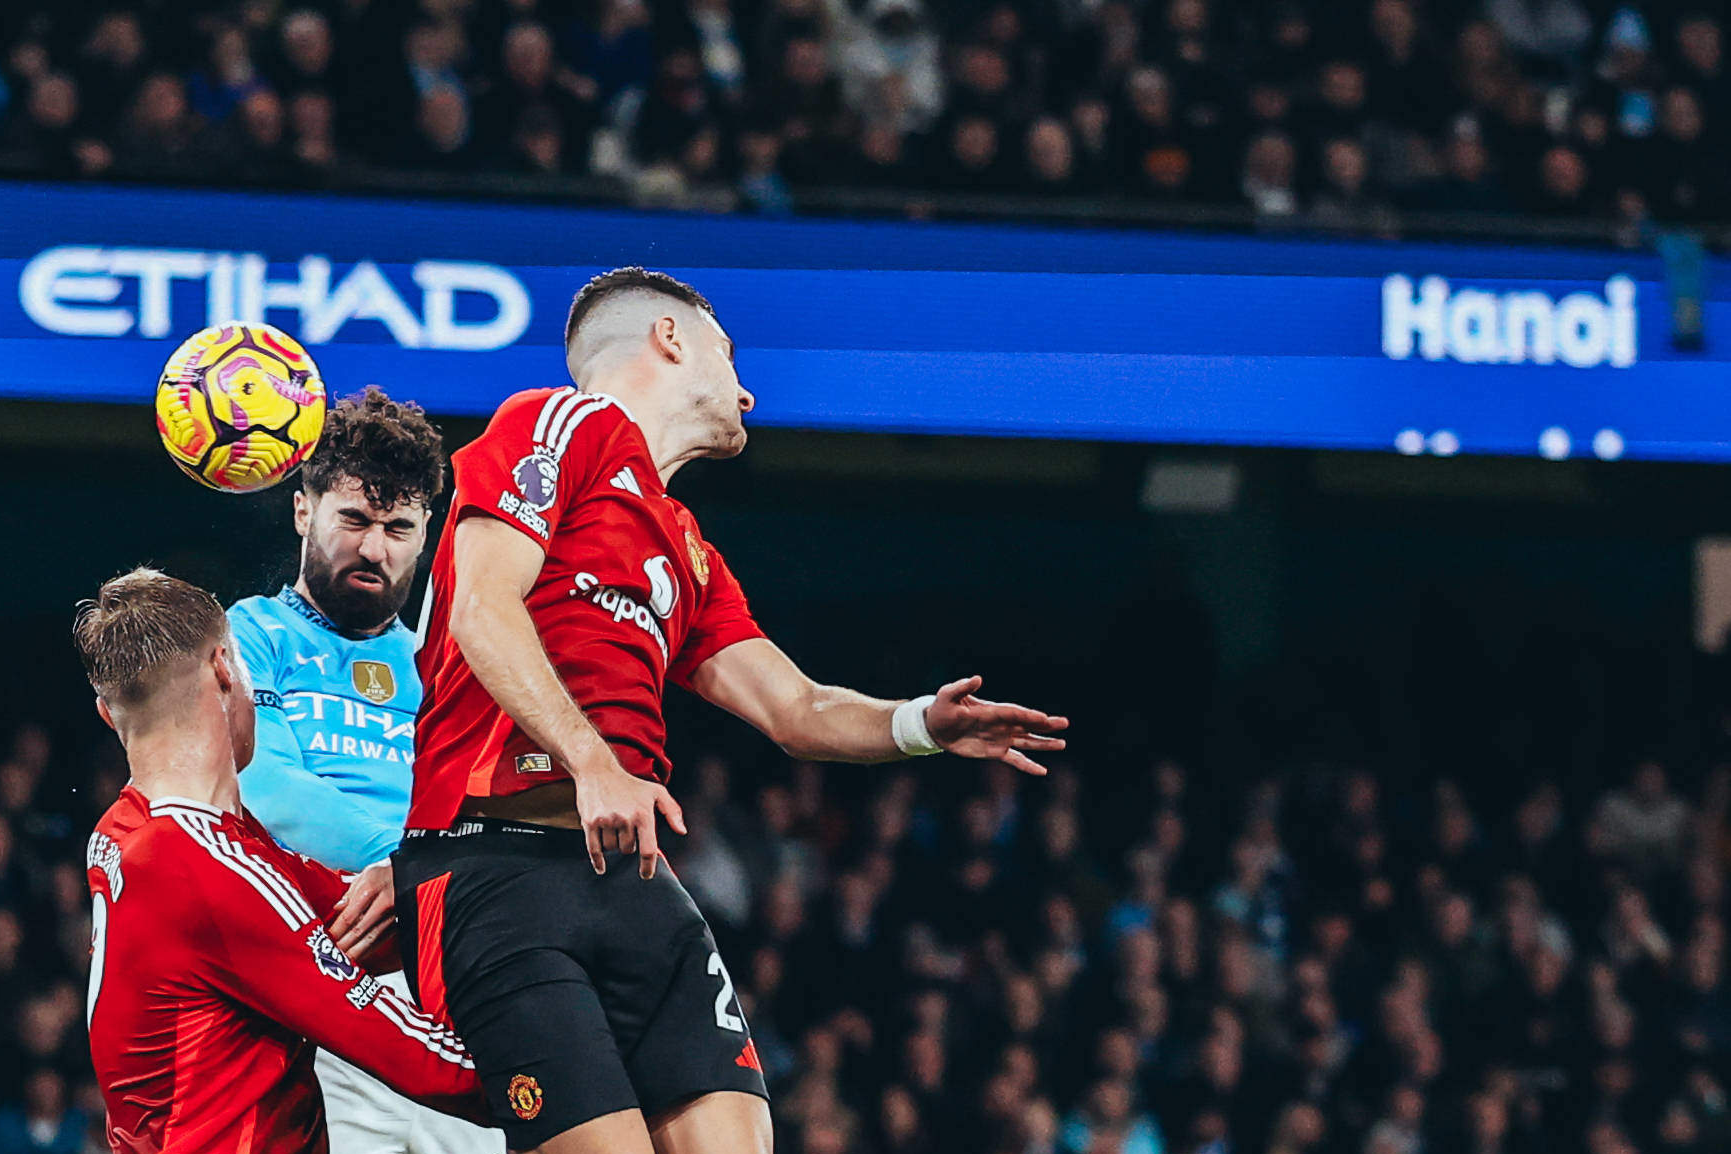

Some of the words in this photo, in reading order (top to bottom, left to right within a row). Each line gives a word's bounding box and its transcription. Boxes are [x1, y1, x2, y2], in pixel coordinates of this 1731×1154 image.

[19, 246, 532, 351] ETIHAD
[1381, 273, 1638, 368] Hanoi
[282, 691, 416, 740] ETIHA
[310, 732, 416, 765] AIRWAY
[708, 951, 749, 1034] 2
